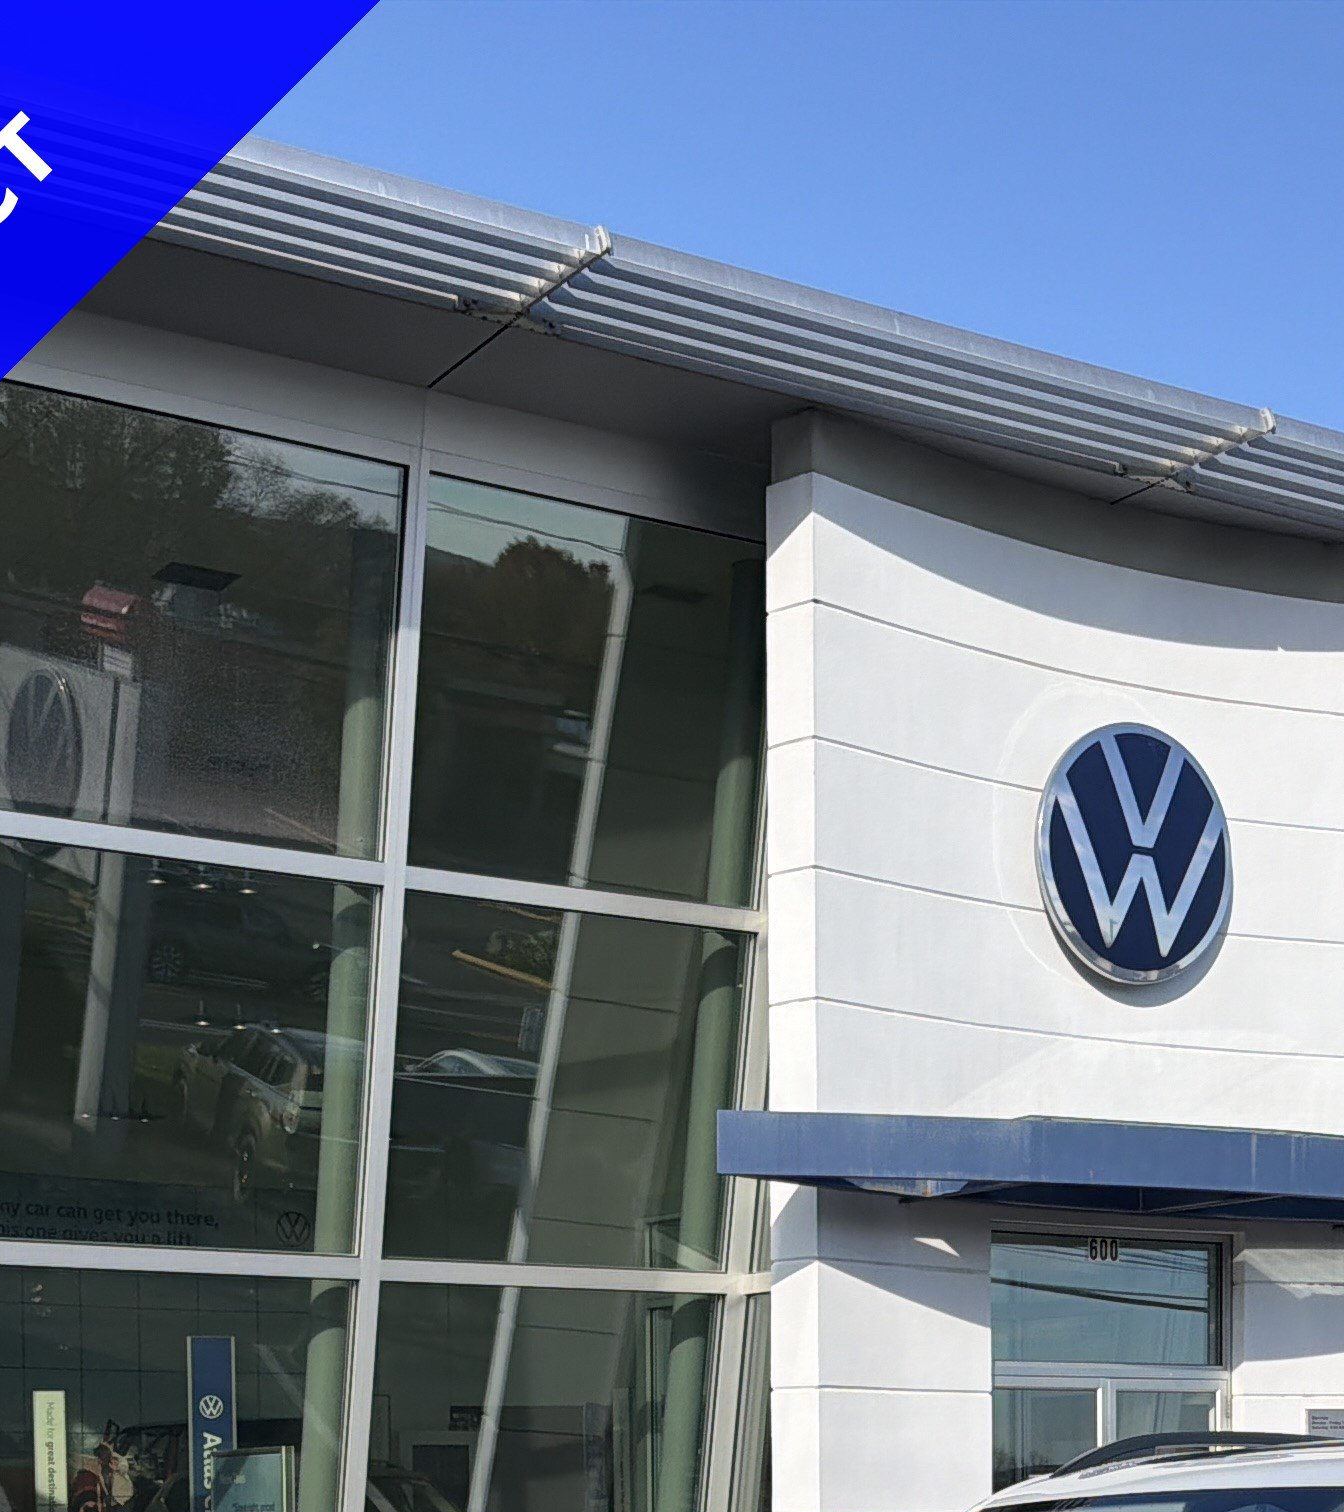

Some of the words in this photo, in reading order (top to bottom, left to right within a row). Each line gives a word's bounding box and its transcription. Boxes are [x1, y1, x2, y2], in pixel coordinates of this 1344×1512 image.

[1035, 723, 1233, 984] VW
[25, 1203, 51, 1217] car
[57, 1204, 87, 1219] can
[94, 1207, 123, 1225] get
[127, 1211, 160, 1227] you
[167, 1209, 219, 1230] there,
[26, 1225, 53, 1238] one
[1089, 1238, 1119, 1262] 600
[47, 1401, 55, 1425] Made
[47, 1427, 55, 1440] for
[45, 1441, 56, 1465] great
